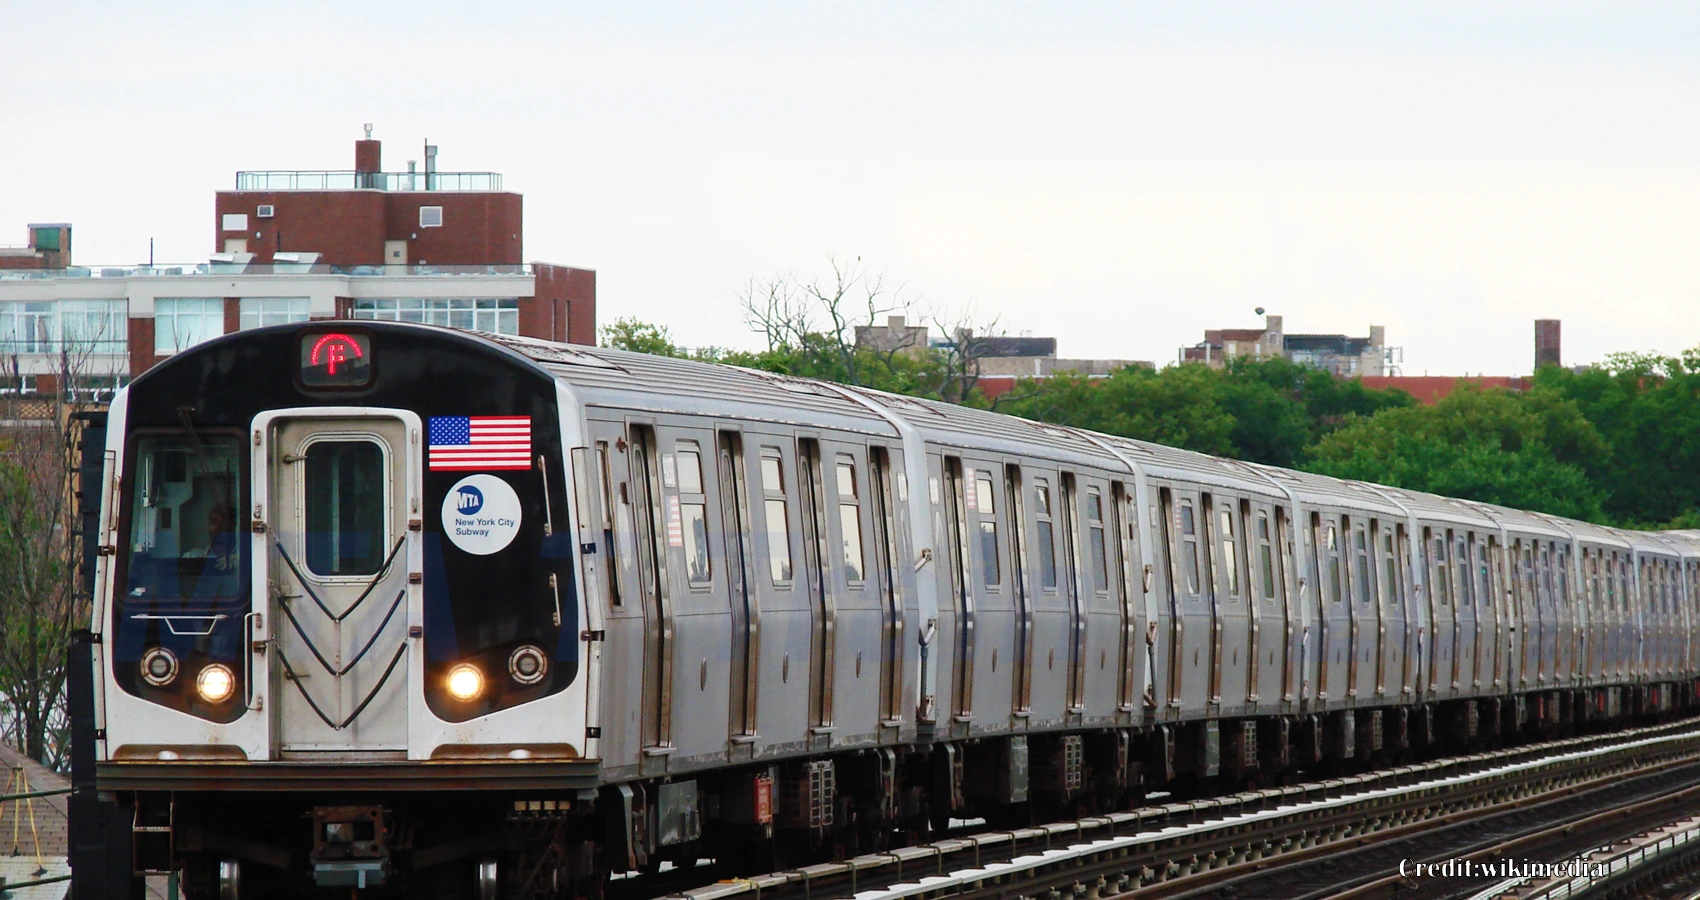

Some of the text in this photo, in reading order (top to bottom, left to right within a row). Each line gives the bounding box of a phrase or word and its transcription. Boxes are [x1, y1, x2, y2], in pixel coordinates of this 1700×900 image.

[328, 344, 345, 375] F
[457, 492, 479, 509] MTA
[455, 518, 514, 527] New York City
[455, 528, 489, 536] Subway
